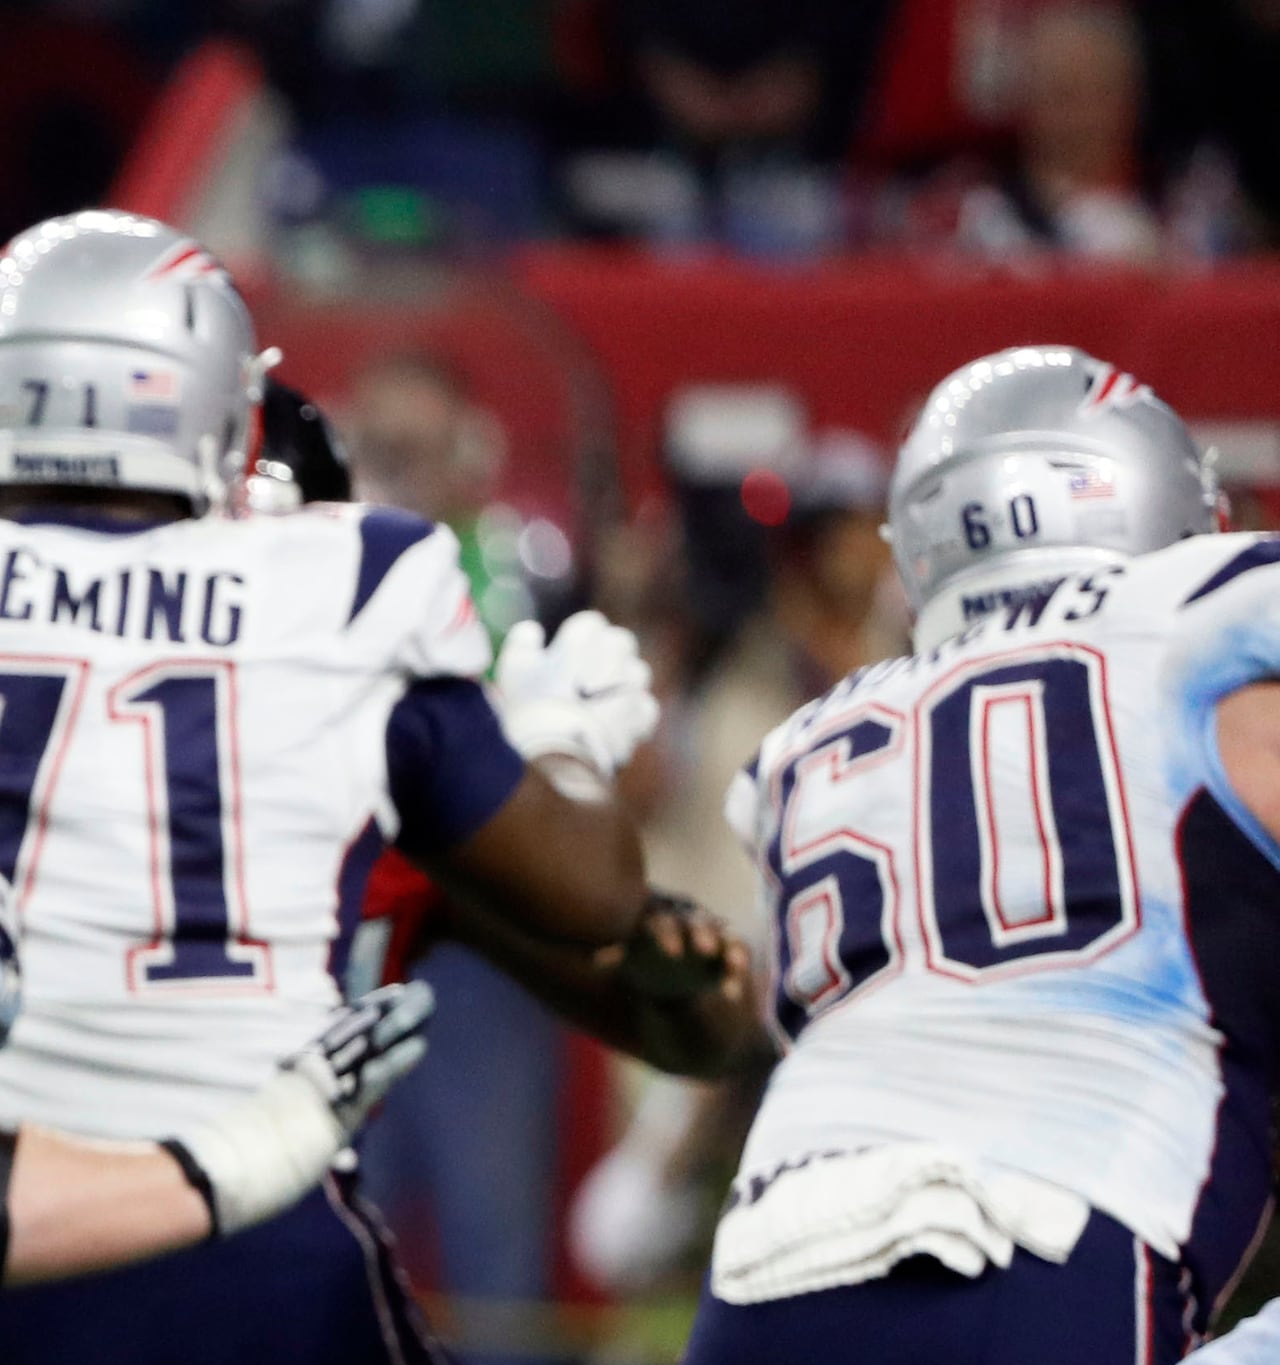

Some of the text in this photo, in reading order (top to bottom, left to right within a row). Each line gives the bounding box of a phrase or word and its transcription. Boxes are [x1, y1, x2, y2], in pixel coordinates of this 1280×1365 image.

[21, 380, 97, 428] 71
[962, 494, 1039, 550] 60
[765, 642, 1141, 1056] 60
